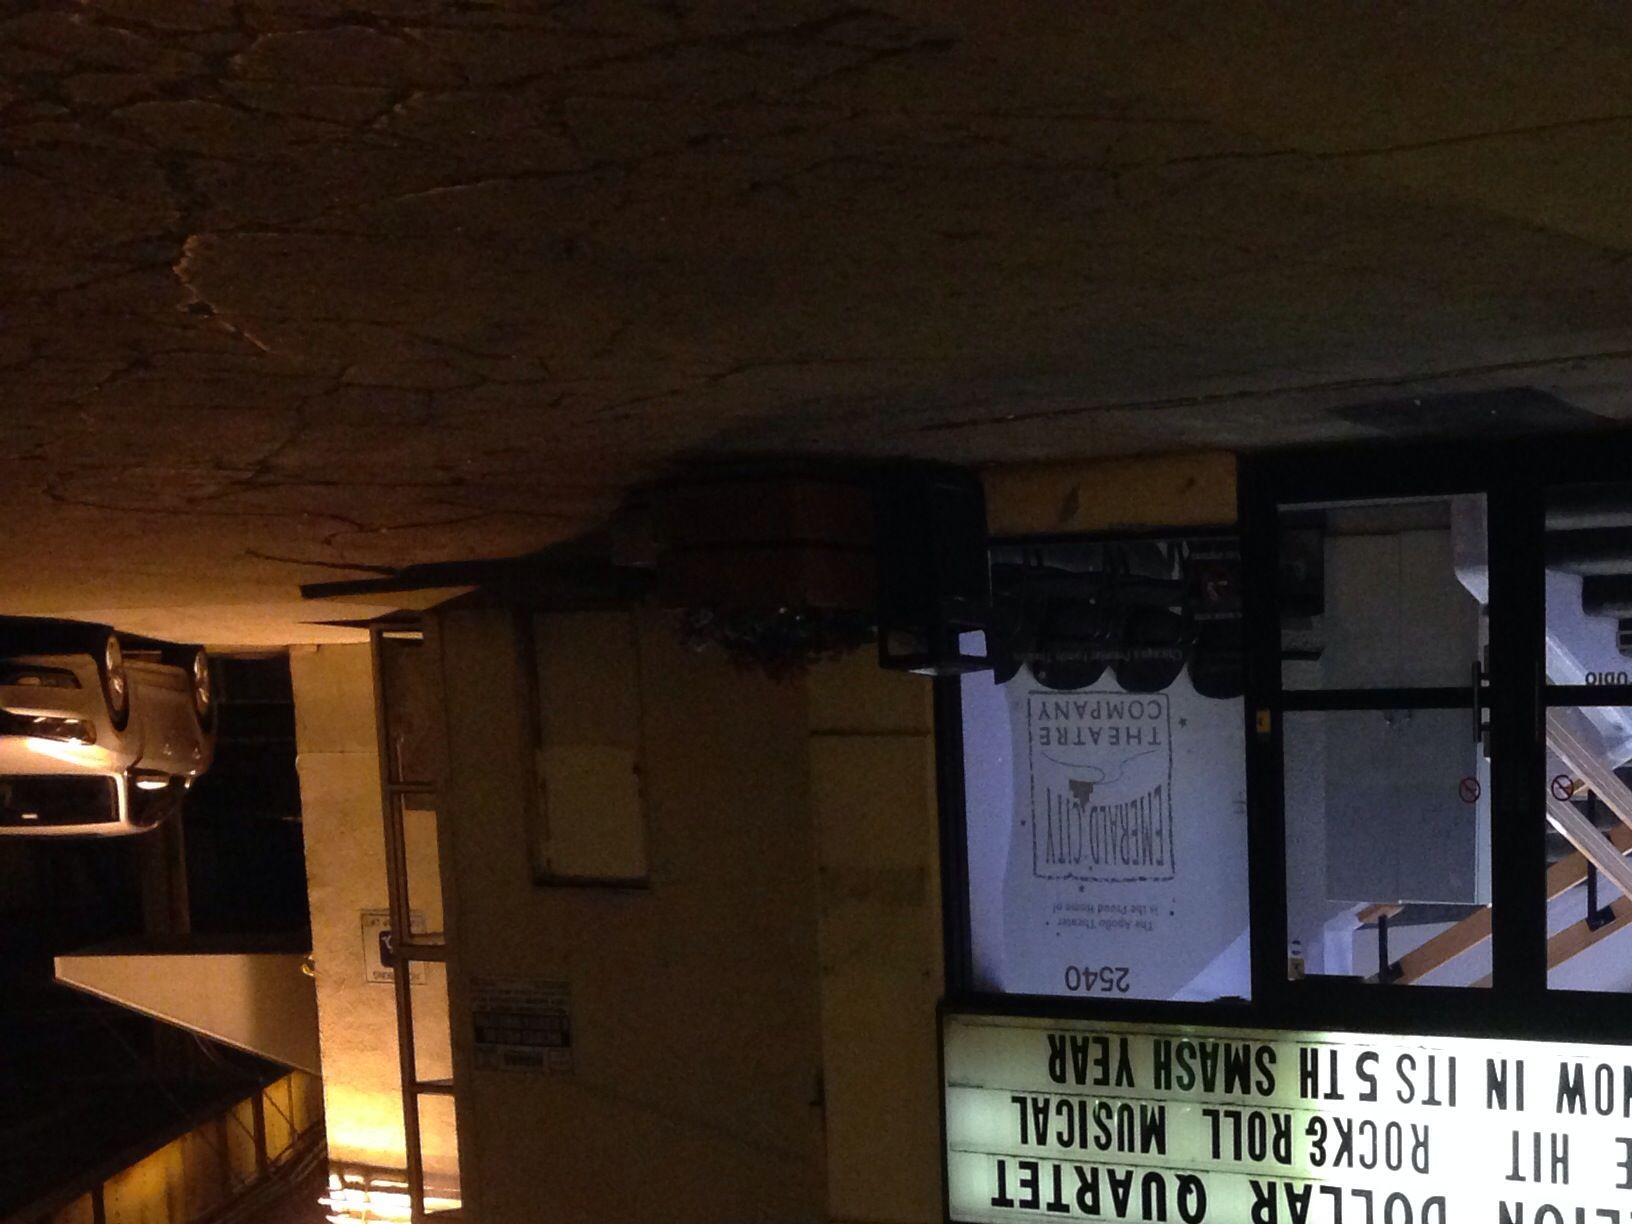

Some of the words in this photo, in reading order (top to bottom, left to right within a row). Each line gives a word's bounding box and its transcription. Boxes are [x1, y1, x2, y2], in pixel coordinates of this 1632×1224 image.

[1037, 699, 1162, 722] COMPANY
[1038, 725, 1161, 746] THEATRE
[1045, 786, 1083, 865] CITY
[1089, 784, 1164, 866] EMERALD
[1135, 919, 1153, 932] The
[1064, 966, 1130, 993] 2540
[1046, 1032, 1132, 1090] YEAR
[1152, 1038, 1277, 1097] SMASH
[1395, 1052, 1456, 1106] ITS
[1485, 1057, 1524, 1111] IN
[1010, 1095, 1167, 1156] MUSICAL
[1505, 1129, 1569, 1185] HIT
